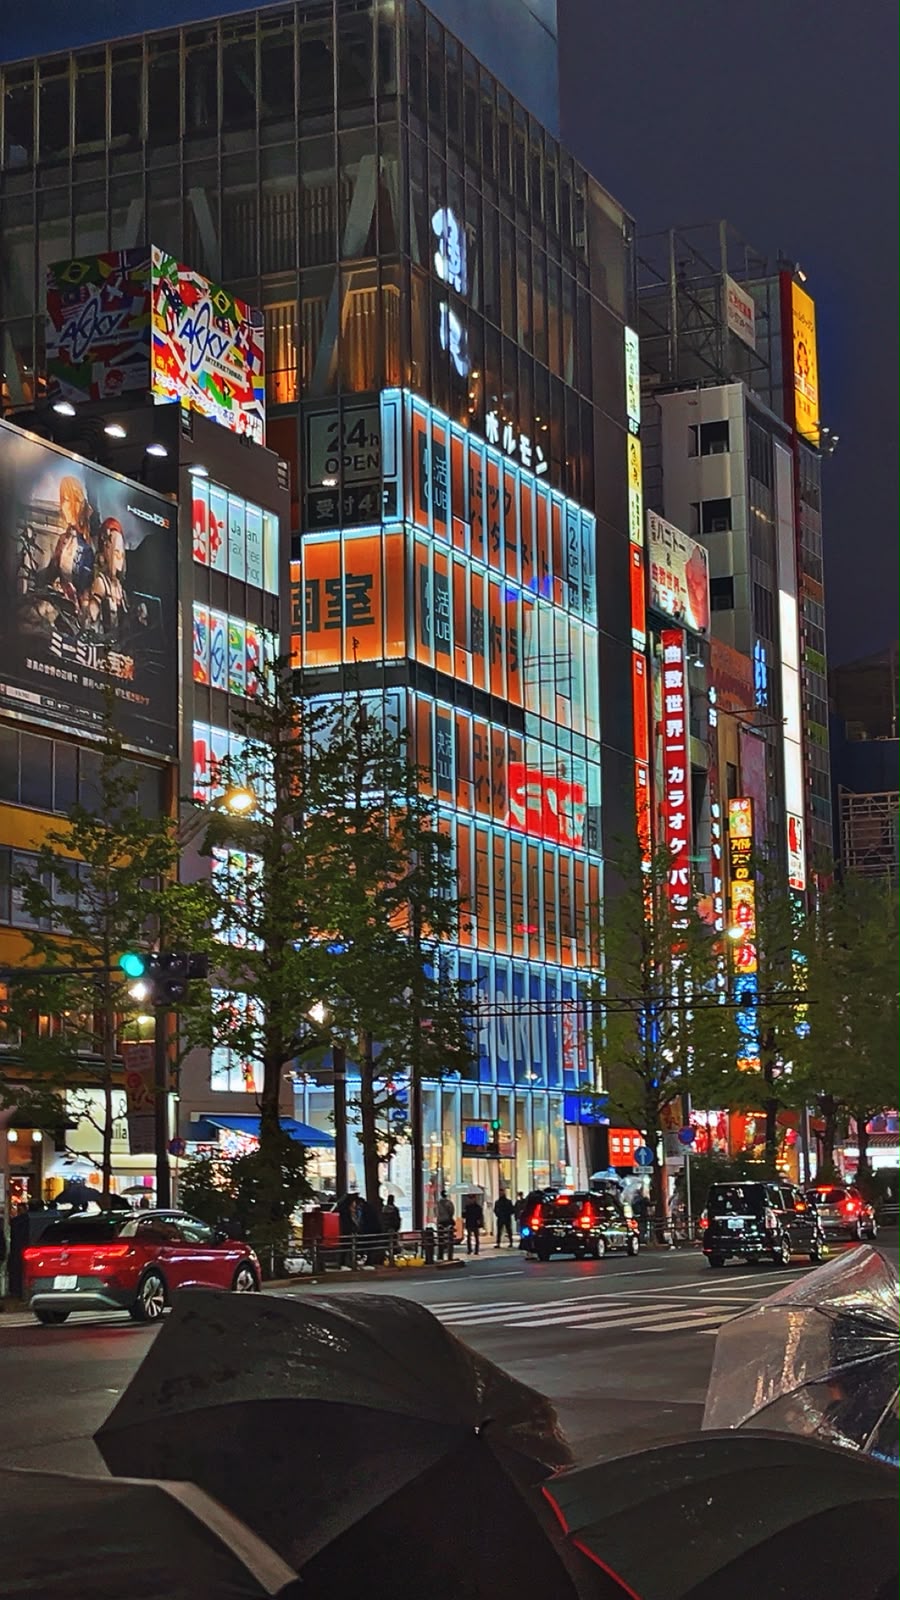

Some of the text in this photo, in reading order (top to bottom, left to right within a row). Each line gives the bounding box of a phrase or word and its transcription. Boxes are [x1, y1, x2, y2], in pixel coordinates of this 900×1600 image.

[326, 417, 380, 453] 24h
[485, 411, 547, 475] ホルモン
[325, 454, 380, 475] OPEN
[424, 481, 448, 510] CUB
[657, 521, 687, 552] ハニトー
[425, 614, 450, 641] CUB
